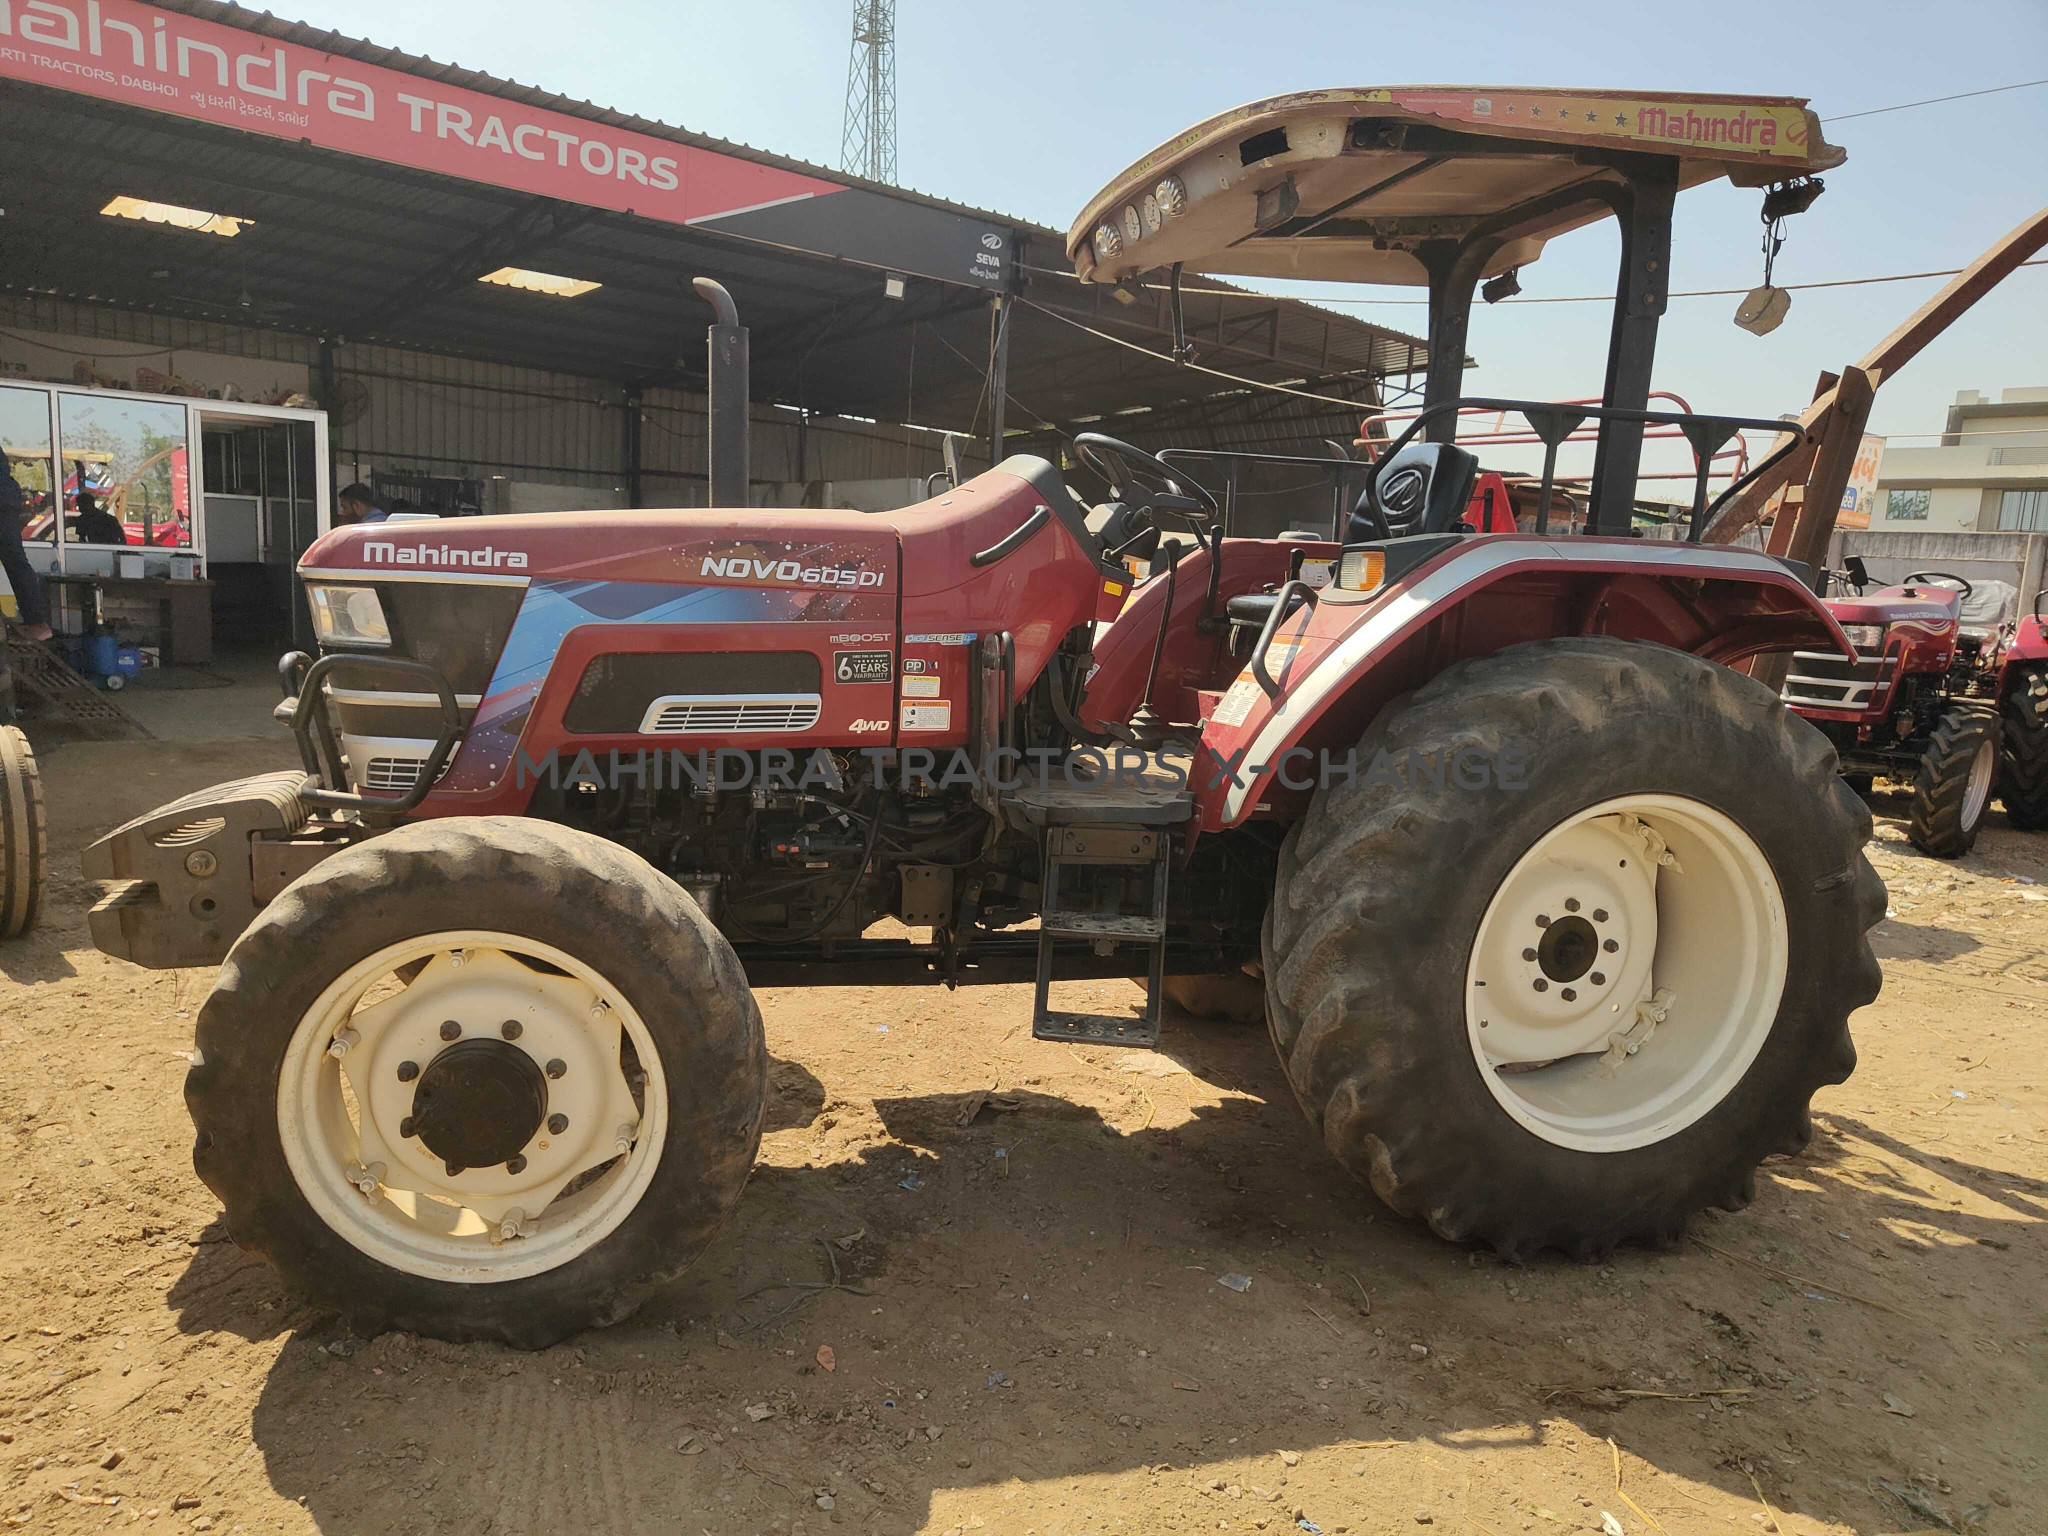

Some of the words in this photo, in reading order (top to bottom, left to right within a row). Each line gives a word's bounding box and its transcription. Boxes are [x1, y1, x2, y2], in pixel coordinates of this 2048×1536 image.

[30, 53, 118, 86] TRACTORS,
[121, 74, 179, 97] DABHOI
[0, 0, 375, 121] ahindra
[397, 92, 679, 190] TRACTORS
[1637, 107, 1777, 146] Mahindra
[975, 252, 1000, 268] SEVA
[363, 542, 529, 568] Mahindra
[700, 556, 801, 581] NOVO
[838, 657, 852, 680] 6
[848, 719, 890, 734] 4WD
